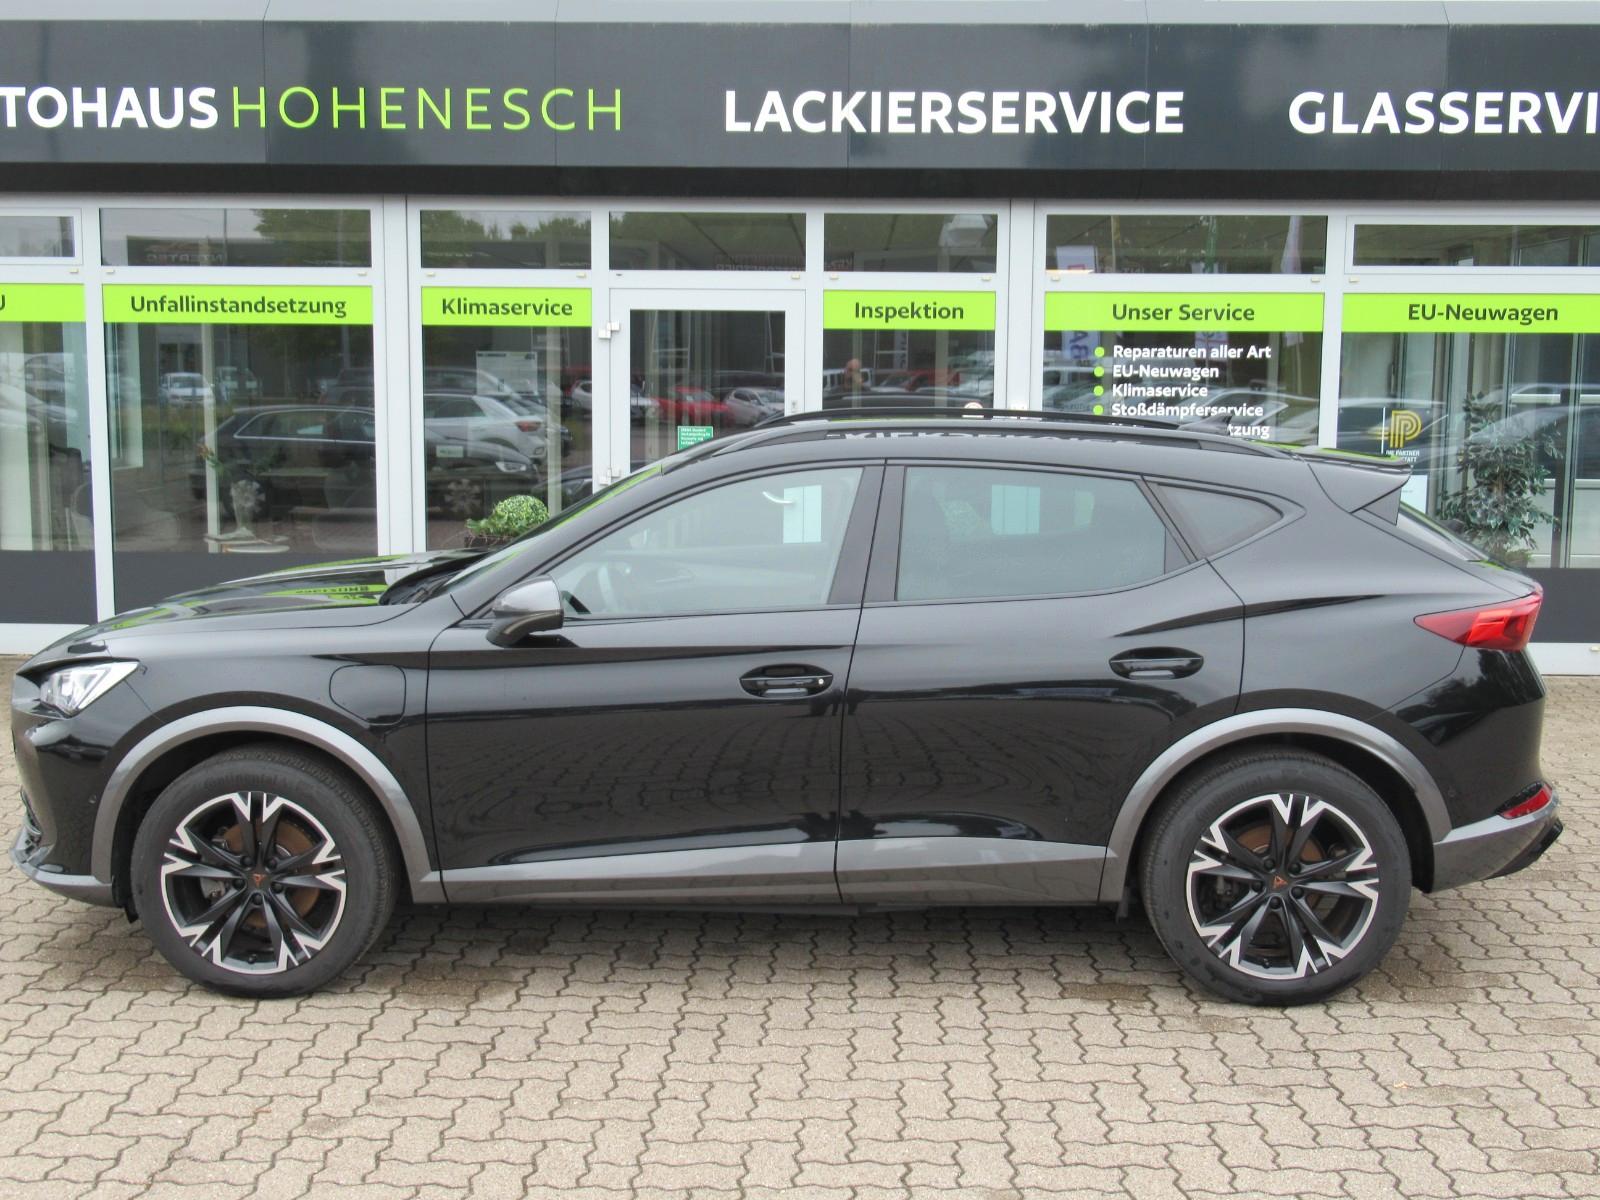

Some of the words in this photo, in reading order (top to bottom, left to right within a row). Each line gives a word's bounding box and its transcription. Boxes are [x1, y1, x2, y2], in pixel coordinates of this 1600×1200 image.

[0, 86, 219, 129] TOHAUS
[232, 86, 622, 132] HOHENESCH
[725, 91, 1185, 134] LACKIERSERVICE
[1289, 91, 1599, 134] GLASSERVI
[131, 295, 347, 318] Unfallinstandsetzung
[442, 298, 573, 316] Klimaservice
[855, 302, 964, 323] Inspektion
[1112, 304, 1173, 321] Unser
[1179, 303, 1255, 321] Service
[1408, 303, 1558, 326] EU-Neuwagen
[1113, 345, 1207, 361] Reparaturen
[1210, 345, 1243, 359] aller
[1246, 346, 1272, 359] Art
[1112, 364, 1220, 381] EU-Neuwagen
[1112, 383, 1208, 398] Klimaservice
